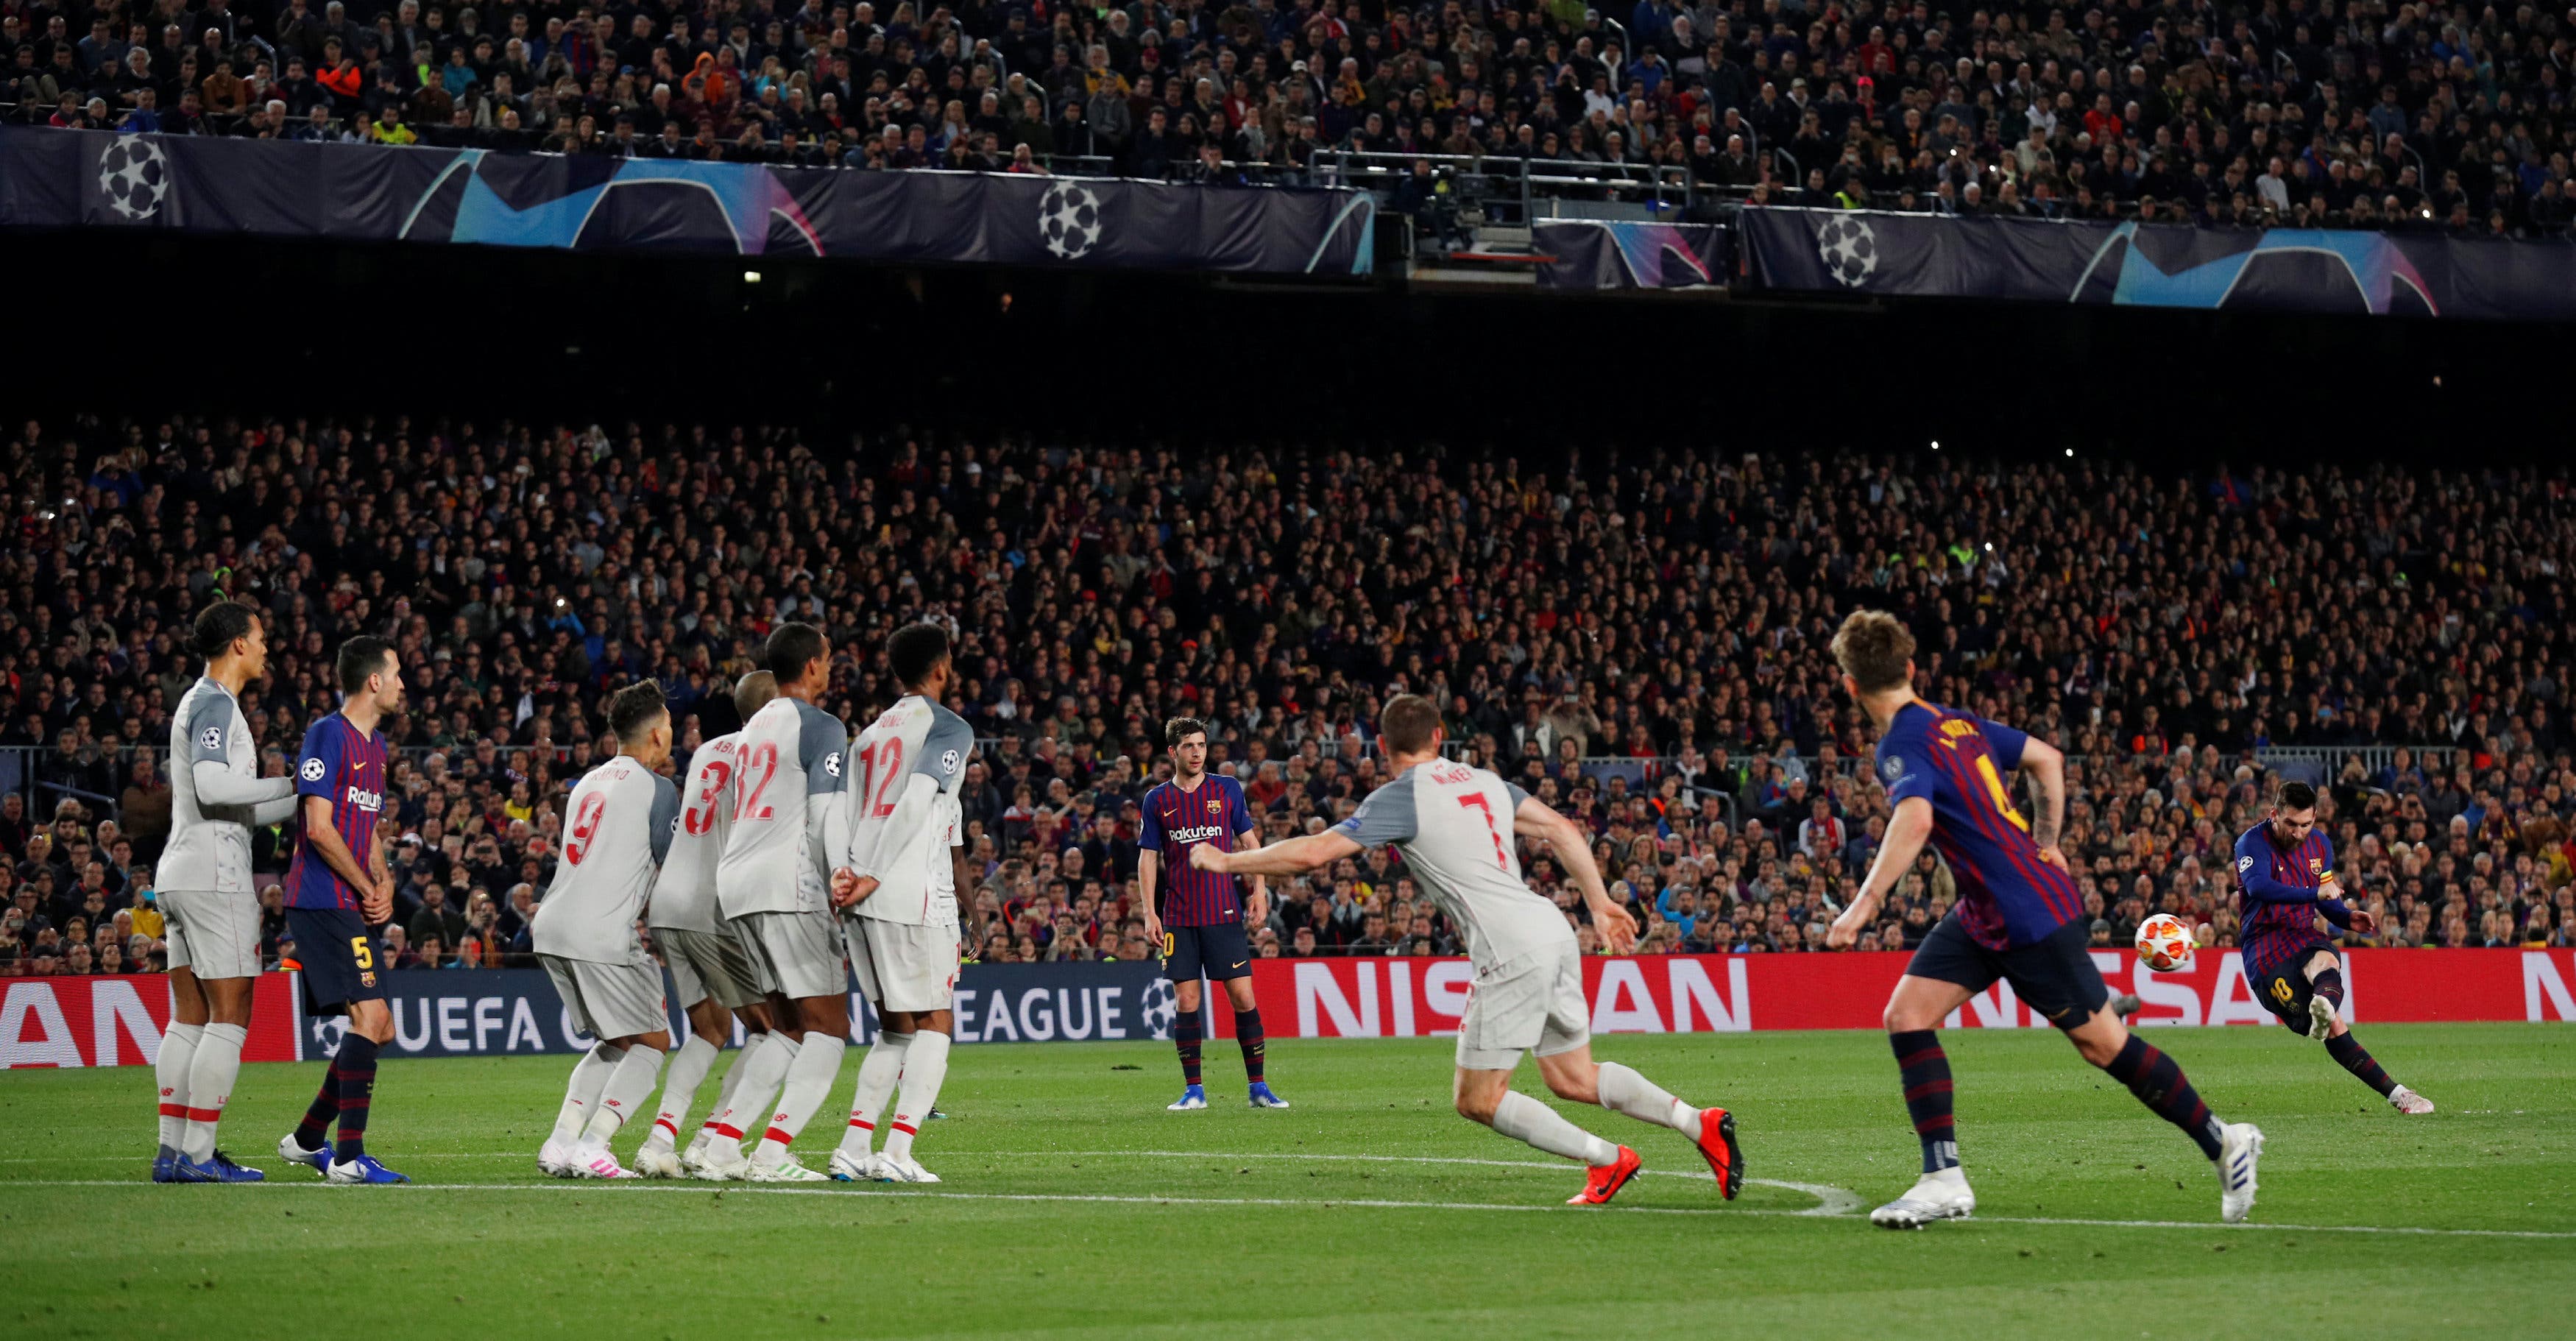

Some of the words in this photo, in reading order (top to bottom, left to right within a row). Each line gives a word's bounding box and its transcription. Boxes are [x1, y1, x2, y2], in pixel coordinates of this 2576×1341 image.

[347, 785, 382, 811] Rakut
[684, 761, 732, 838] 3
[732, 741, 778, 824] 32
[860, 736, 904, 820] 12
[566, 790, 606, 868] 9
[1169, 824, 1222, 844] Rakuten
[1457, 792, 1507, 870] 7
[350, 936, 372, 969] 5
[1163, 932, 1175, 957] 0
[0, 980, 177, 1069] AN
[392, 997, 545, 1052] UEFA
[953, 986, 1127, 1042] EAGUE
[1294, 958, 1752, 1039] NISAN
[2270, 977, 2294, 1008] 10
